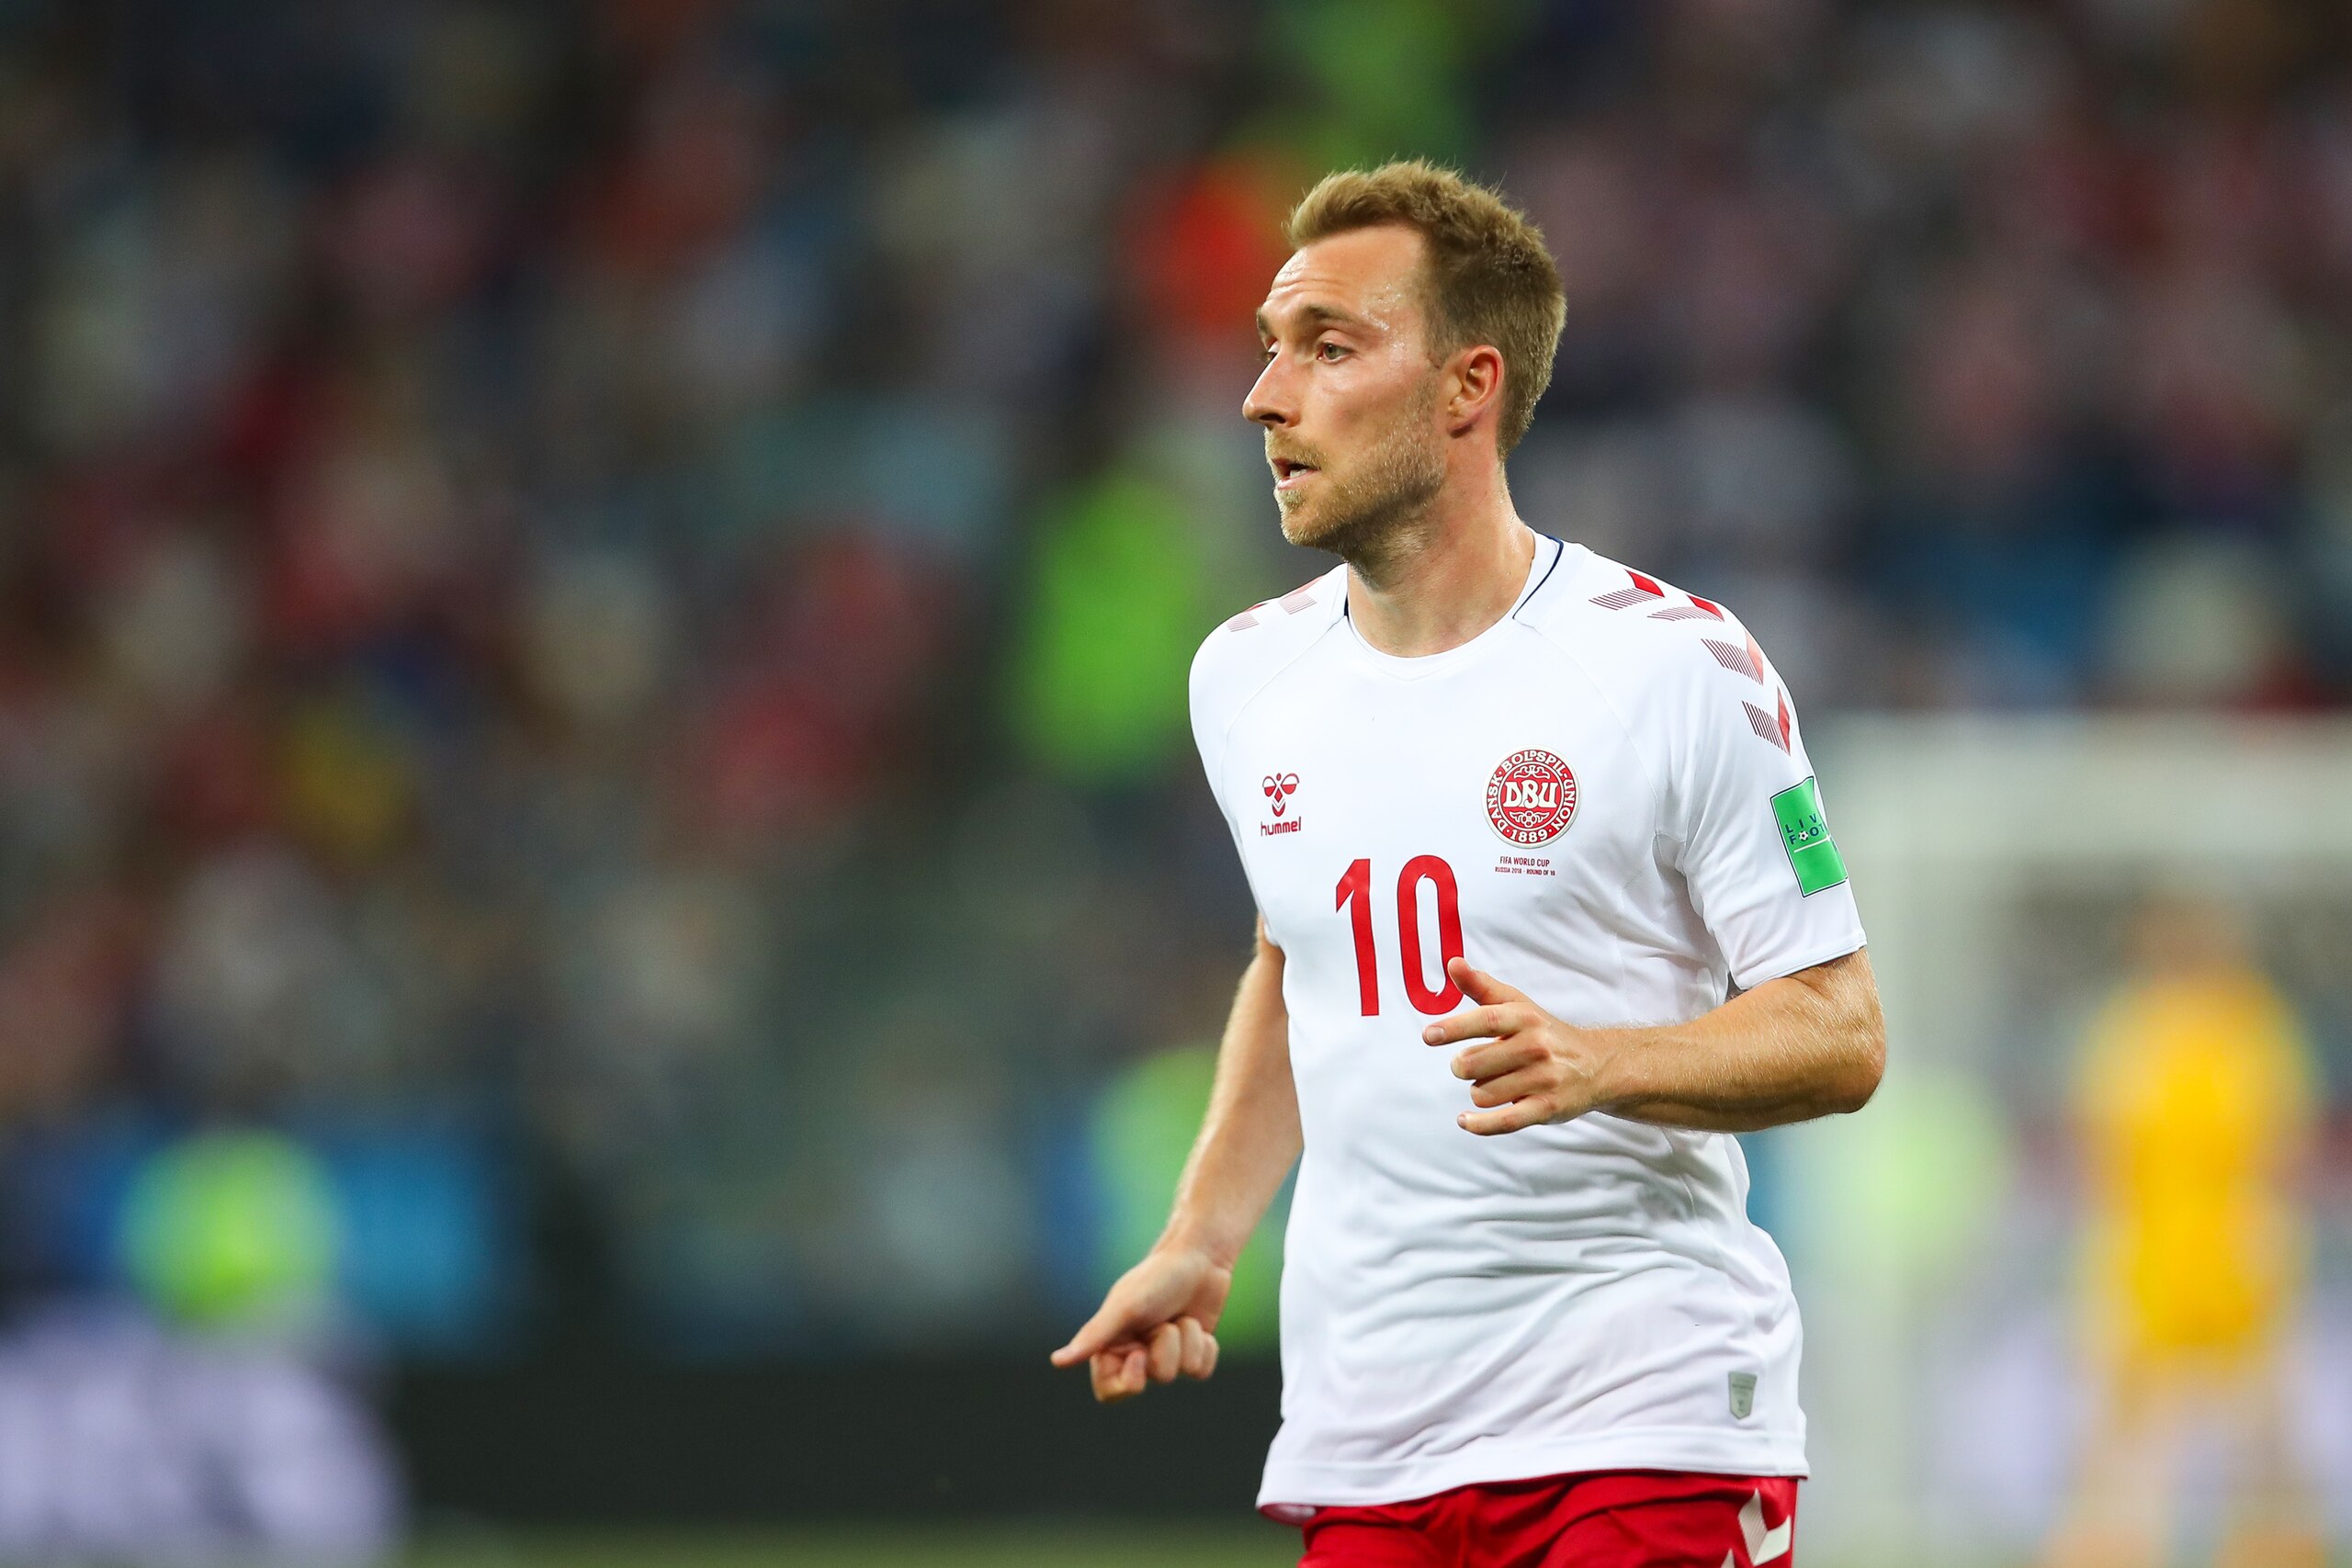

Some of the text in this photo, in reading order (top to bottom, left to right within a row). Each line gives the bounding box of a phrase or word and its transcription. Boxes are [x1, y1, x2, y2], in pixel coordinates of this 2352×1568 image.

[1487, 773, 1508, 832] DANSK
[1503, 780, 1558, 808] DBU
[1261, 816, 1301, 837] hummel
[1510, 829, 1547, 842] 1889
[1499, 856, 1550, 867] FIFA WORLD CUP
[1336, 855, 1464, 1016] 10
